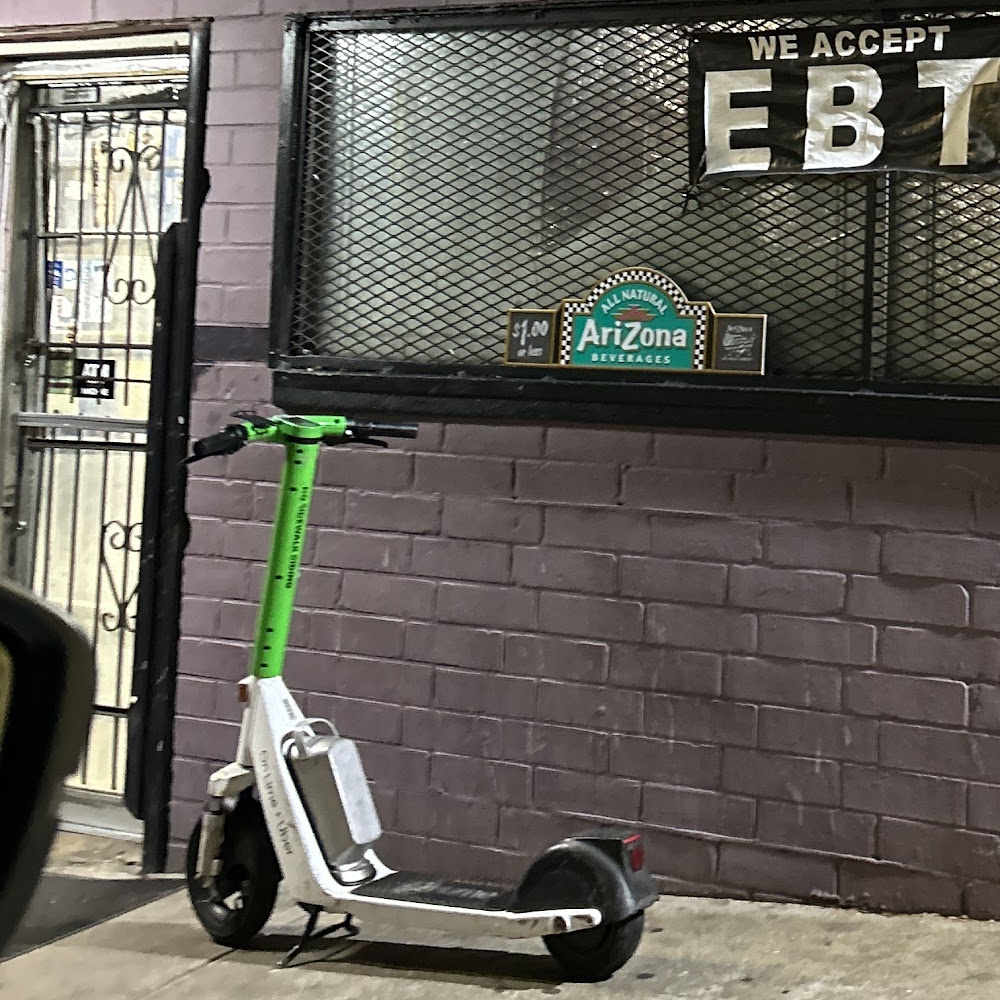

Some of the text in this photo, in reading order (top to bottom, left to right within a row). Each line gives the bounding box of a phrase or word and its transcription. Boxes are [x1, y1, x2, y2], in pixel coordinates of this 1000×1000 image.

[748, 25, 950, 61] WE ACCEPT
[601, 289, 668, 315] ALL NATURAL
[512, 319, 549, 346] $1.00
[576, 318, 687, 351] AriZona
[591, 353, 671, 364] BEVERAGES
[292, 503, 307, 553] SIDEWALK
